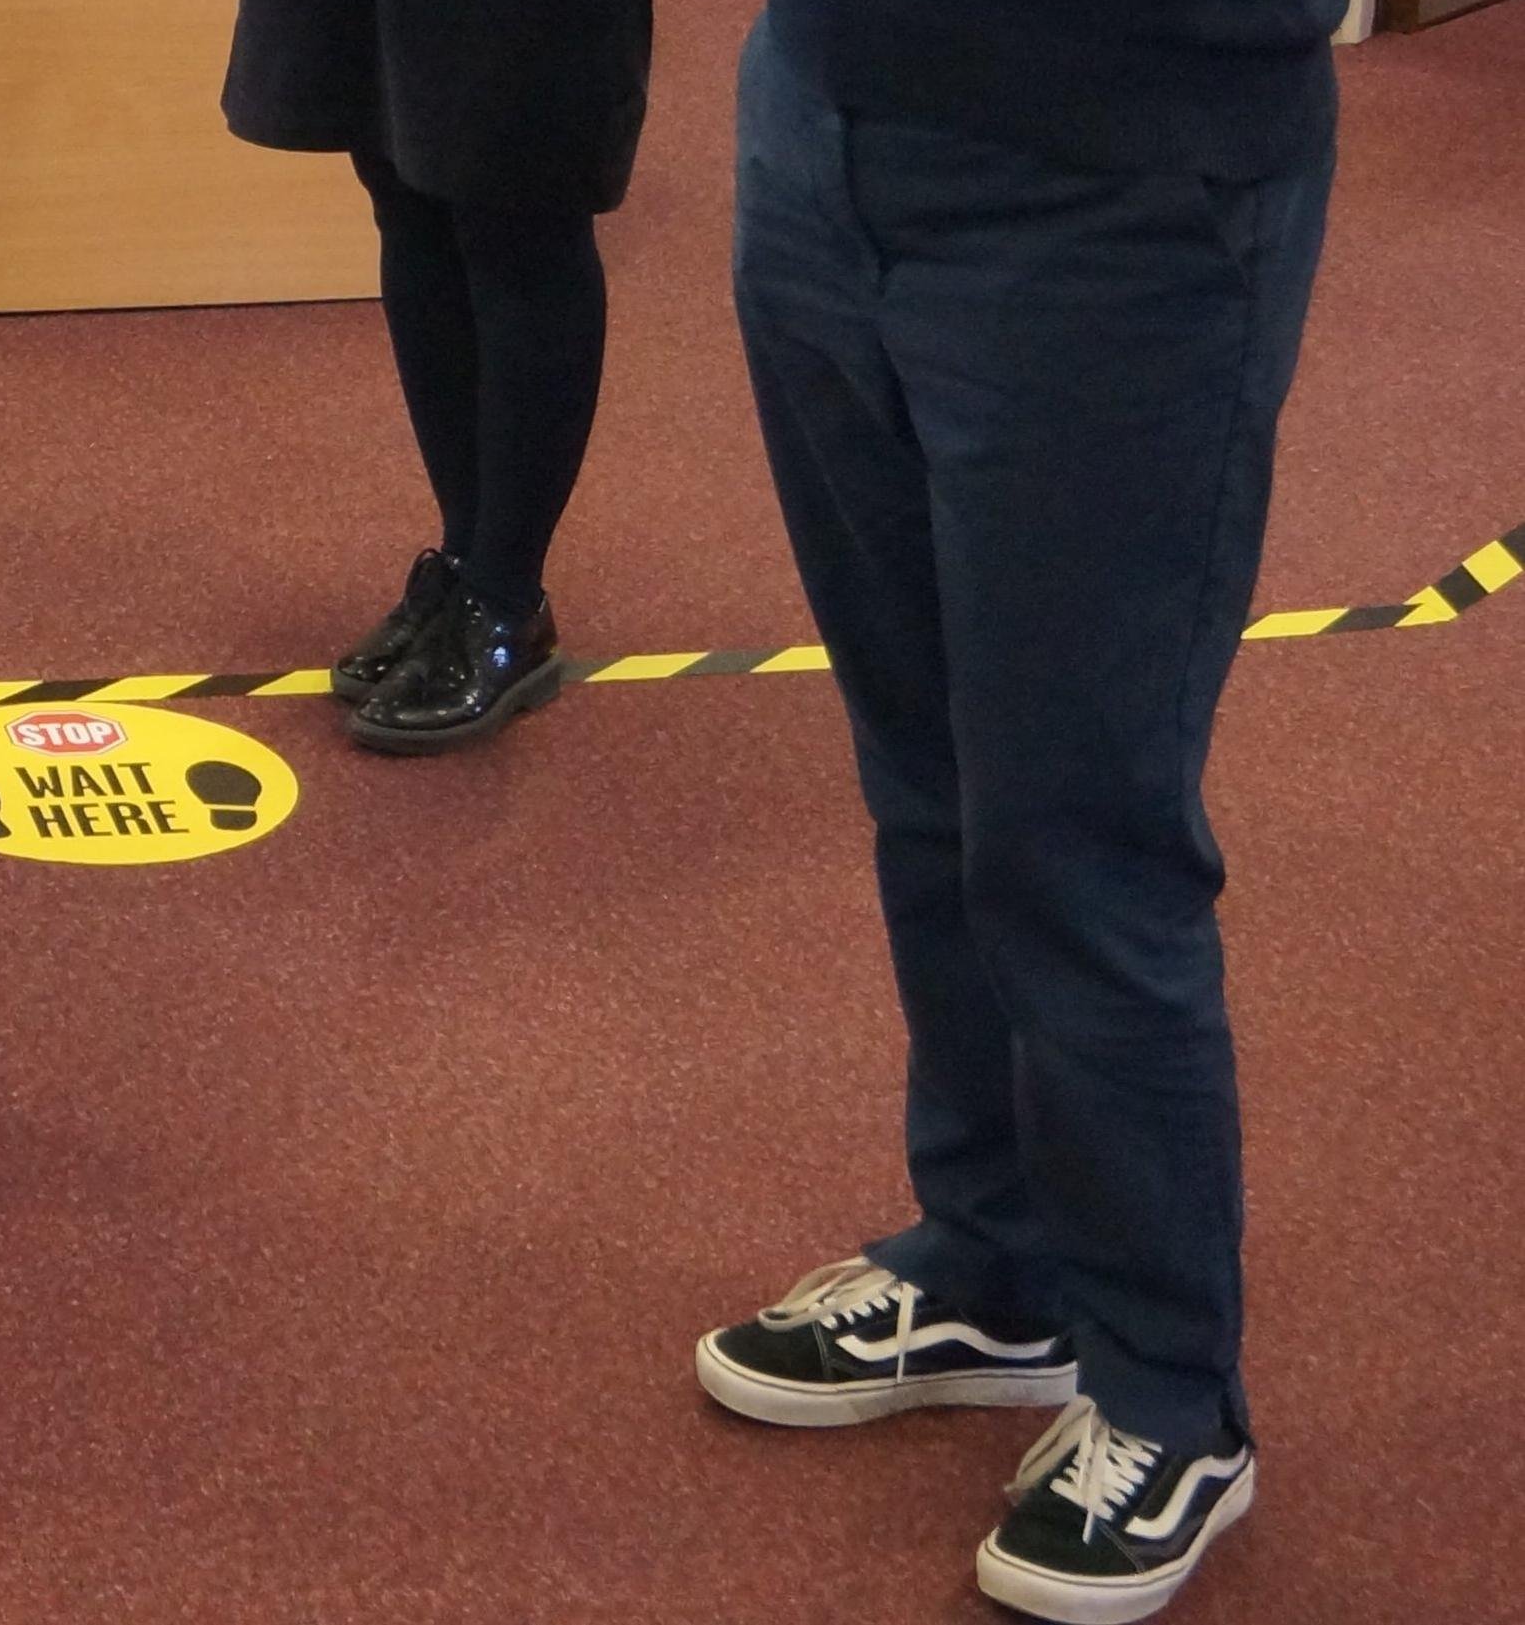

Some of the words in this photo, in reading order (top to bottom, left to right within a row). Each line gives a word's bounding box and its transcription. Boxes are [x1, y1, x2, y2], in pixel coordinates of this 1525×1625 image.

[17, 720, 113, 747] STOP
[14, 762, 156, 799] WAIT
[27, 799, 190, 838] HERE
